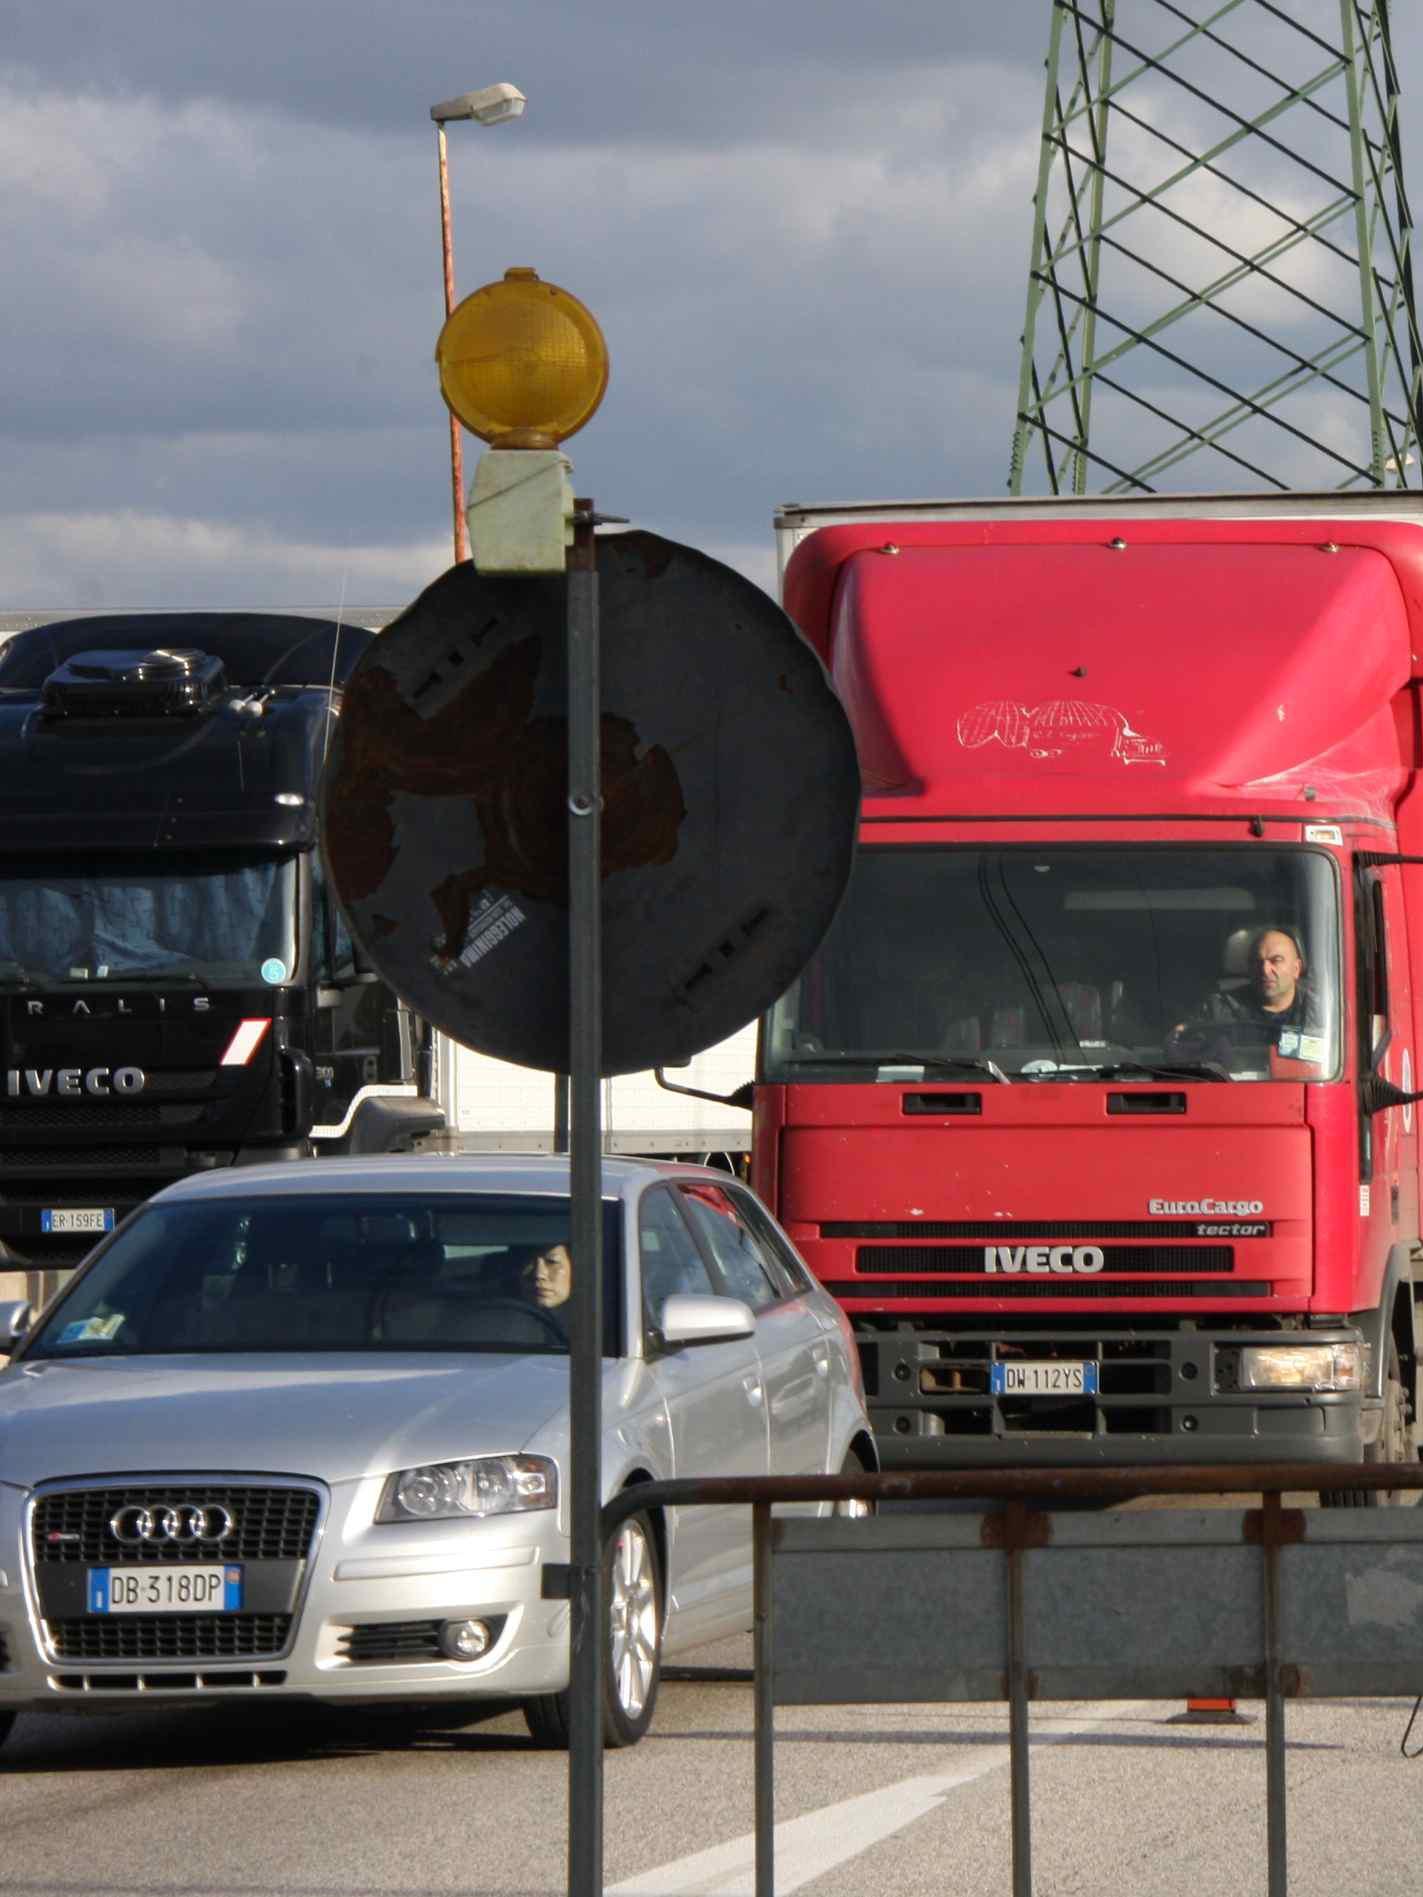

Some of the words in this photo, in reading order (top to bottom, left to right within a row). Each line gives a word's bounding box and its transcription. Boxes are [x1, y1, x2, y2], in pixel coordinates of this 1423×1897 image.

[7, 1066, 145, 1097] IVECO
[1148, 1198, 1264, 1215] EuroCargo
[1196, 1223, 1265, 1236] tector
[983, 1246, 1105, 1273] IVECO
